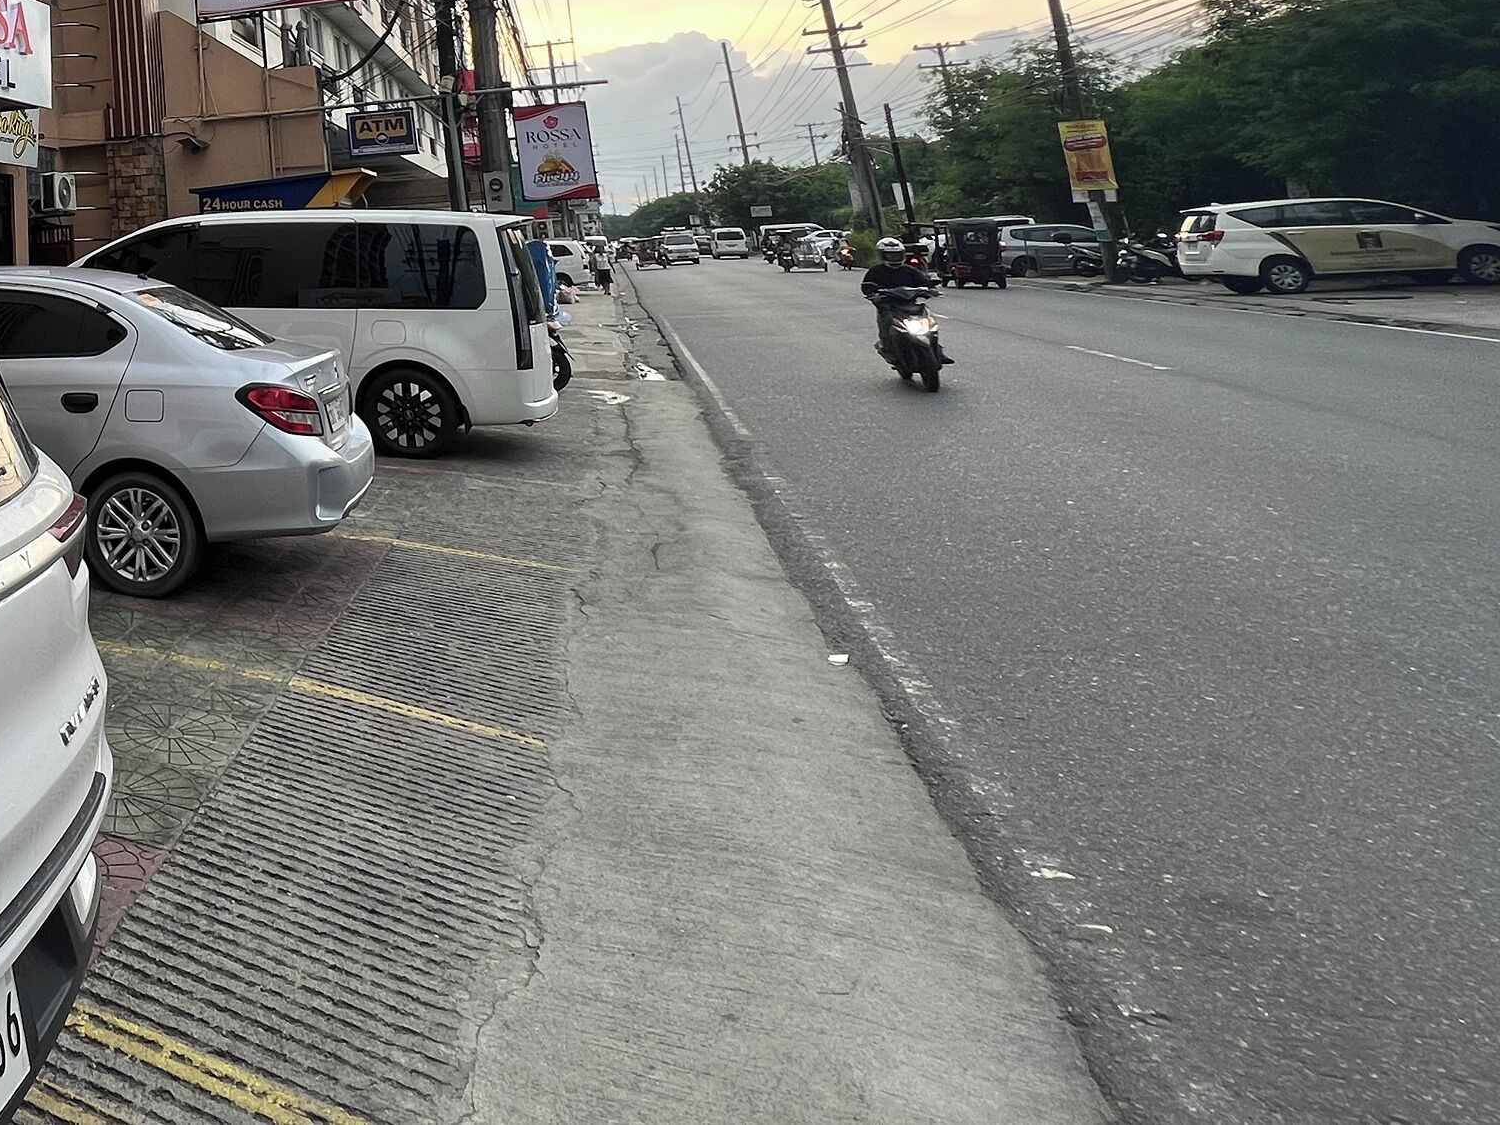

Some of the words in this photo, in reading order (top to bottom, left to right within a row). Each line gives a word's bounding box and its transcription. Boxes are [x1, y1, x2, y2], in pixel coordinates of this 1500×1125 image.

[359, 118, 404, 133] ATM
[525, 128, 582, 144] ROSSA
[533, 142, 577, 150] HOTEL
[203, 197, 220, 210] 24
[222, 200, 251, 210] HOUR
[253, 199, 283, 209] CASH
